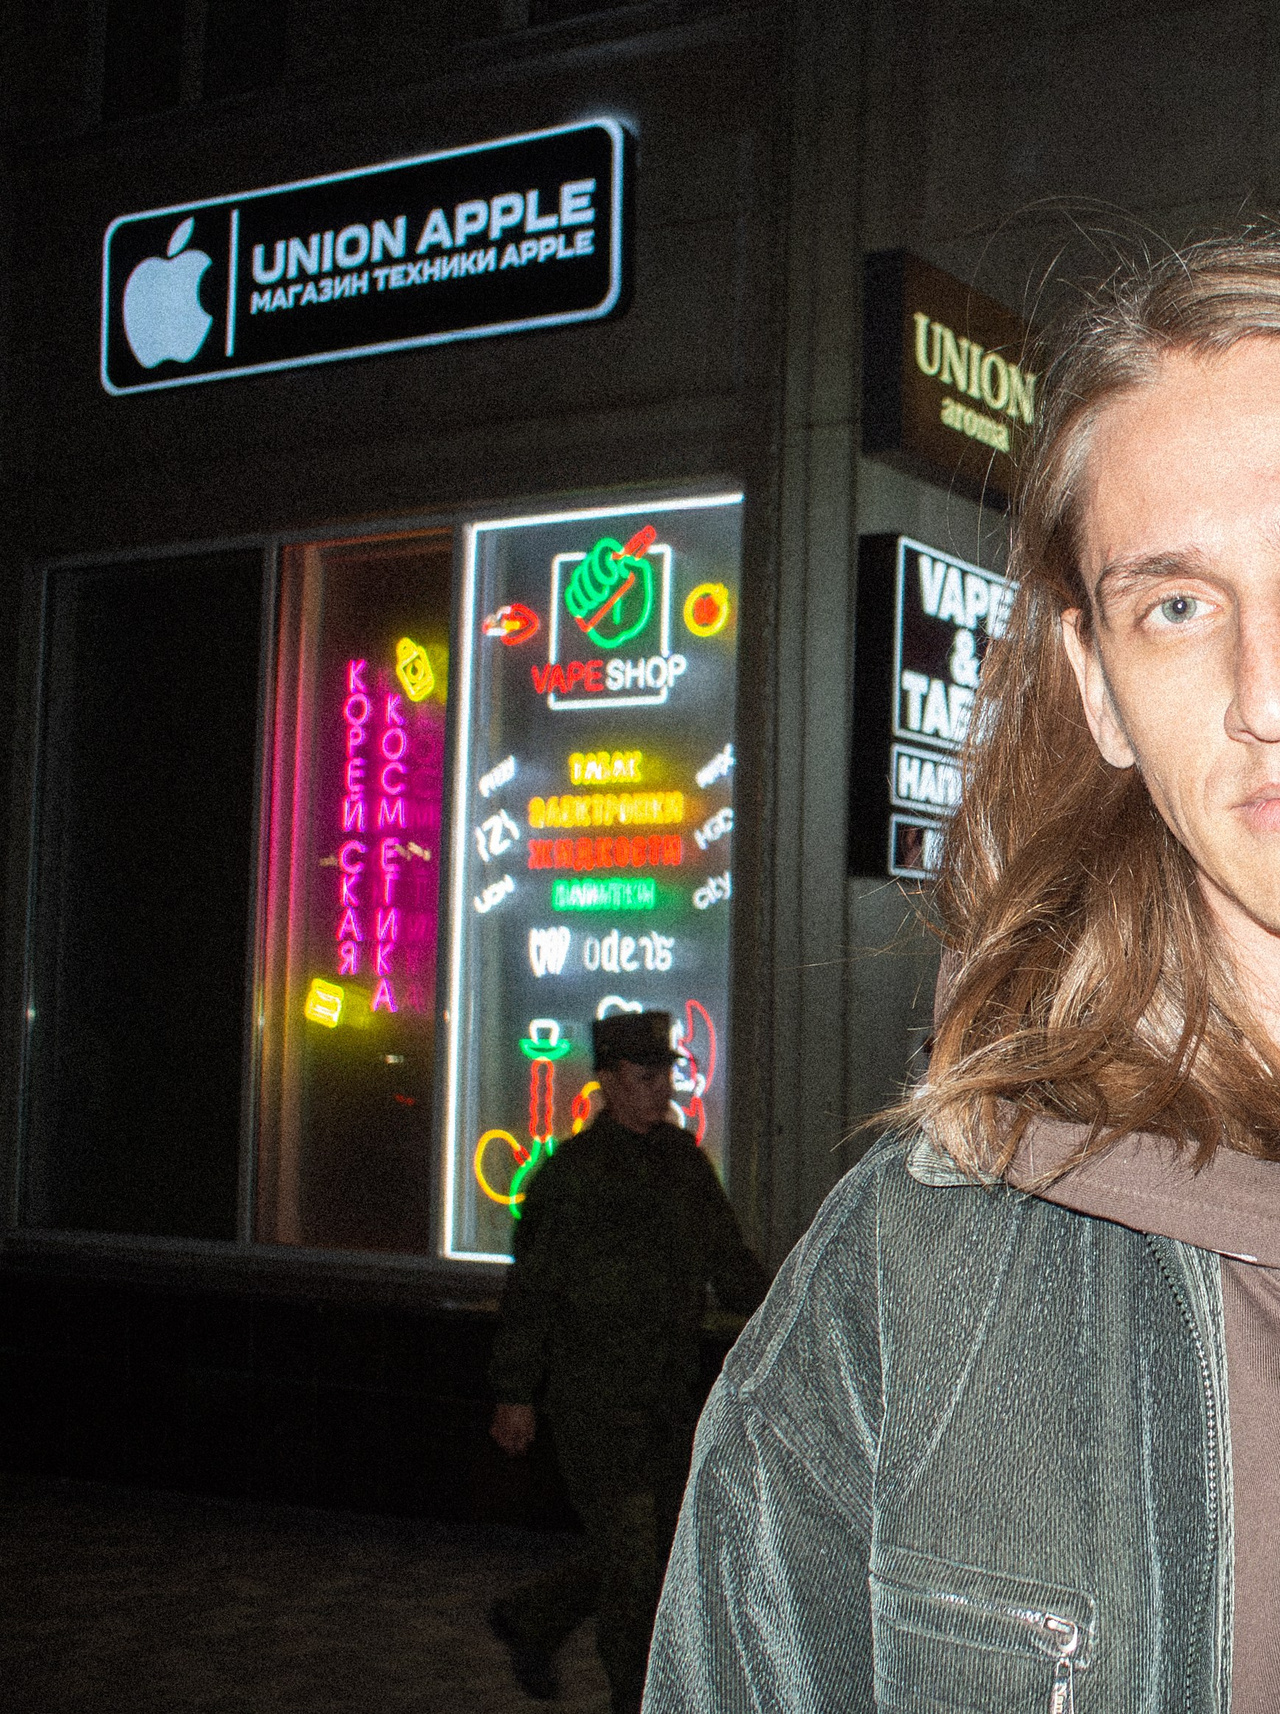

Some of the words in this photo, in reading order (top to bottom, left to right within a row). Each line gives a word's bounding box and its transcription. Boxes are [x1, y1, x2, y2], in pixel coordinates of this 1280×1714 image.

[250, 270, 370, 315] МАГАЗИН
[372, 246, 498, 292] ТЕХНИКИ
[499, 228, 596, 270] APPLE
[252, 214, 407, 285] UNION
[415, 178, 597, 254] APPLE
[913, 311, 1036, 425] UNION
[918, 554, 1015, 640] VAPE
[951, 627, 981, 688] &
[901, 670, 985, 743] ТАБ
[337, 658, 370, 976] КОРЕЙСКАЯ
[371, 692, 408, 1014] КОСМЕТИКА
